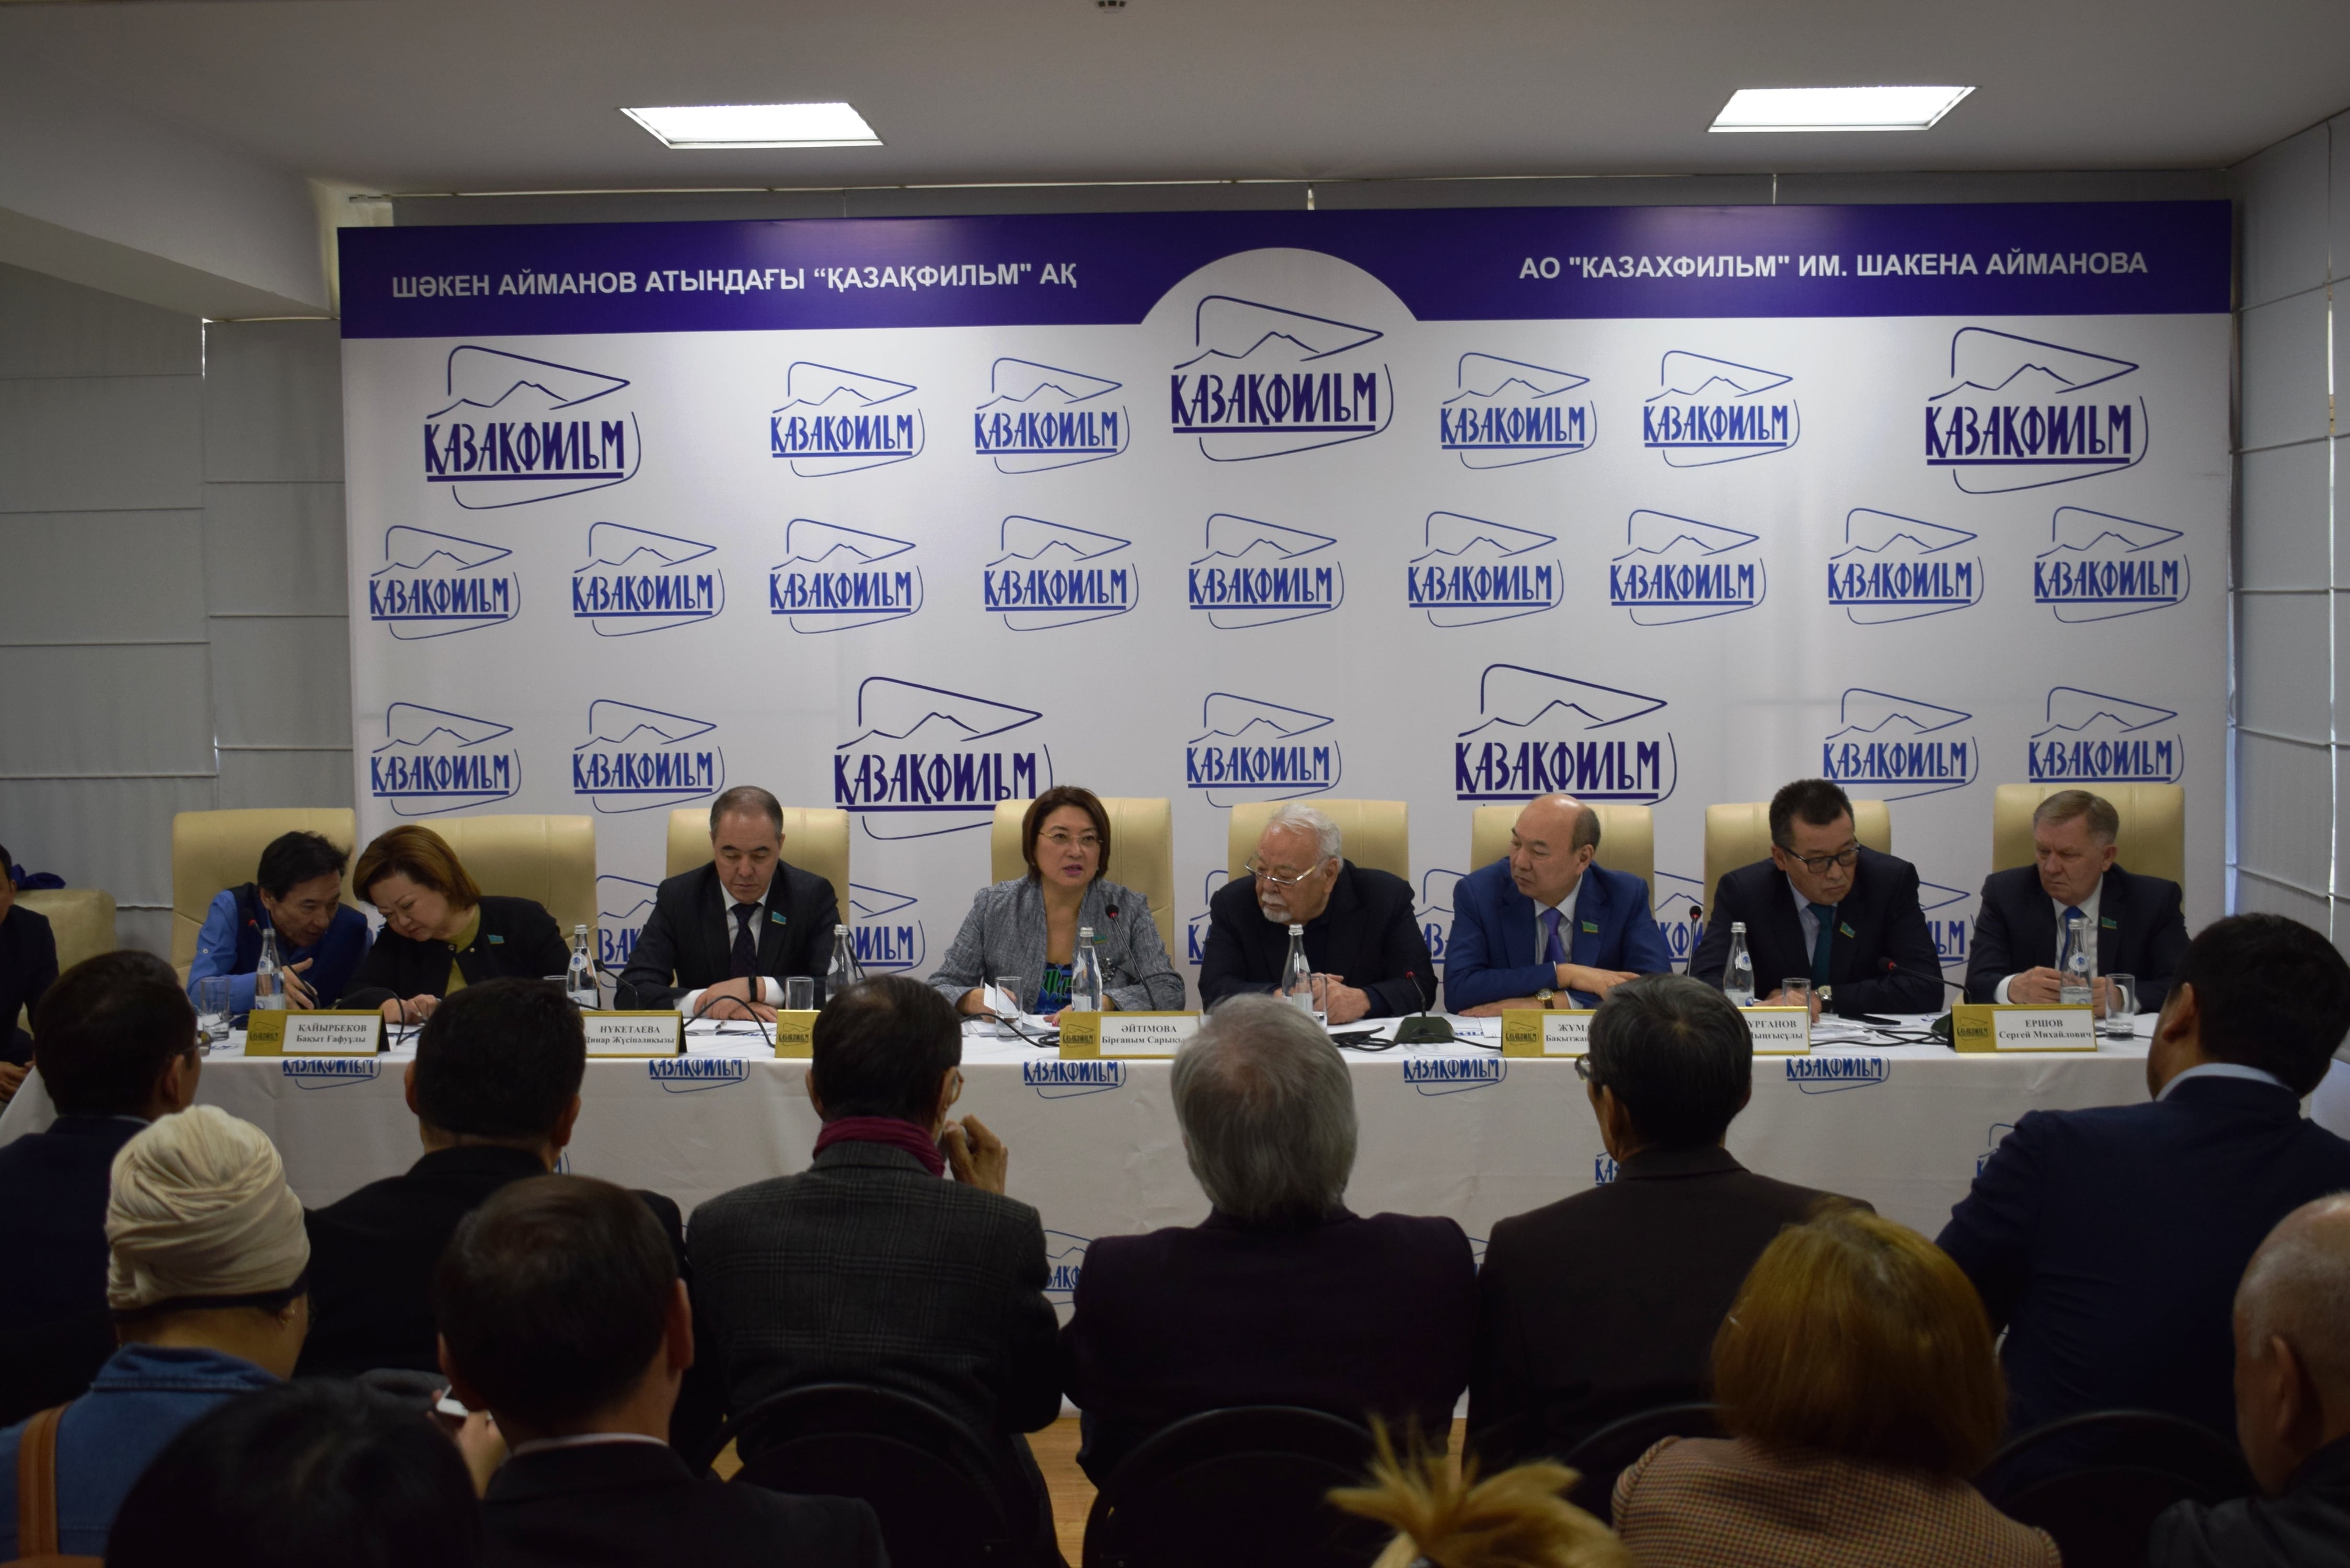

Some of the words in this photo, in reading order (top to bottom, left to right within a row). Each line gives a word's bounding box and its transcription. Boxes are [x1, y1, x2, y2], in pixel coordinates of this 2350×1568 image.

[1519, 257, 1560, 279] АО
[1569, 255, 1790, 278] "КАЗАХФИЛЬМ"
[1799, 255, 1847, 277] ИМ.
[1857, 253, 1978, 276] ШАКЕНА
[1985, 247, 2148, 275] АЙМАНОВА
[393, 276, 489, 298] ШӘКЕН
[498, 268, 637, 295] АЙМАНОВ
[644, 267, 805, 295] АТЫНДАҒЫ
[1040, 263, 1077, 289] АҚ
[1999, 1031, 2031, 1040] Сергей
[2033, 1030, 2091, 1039] Михайлович
